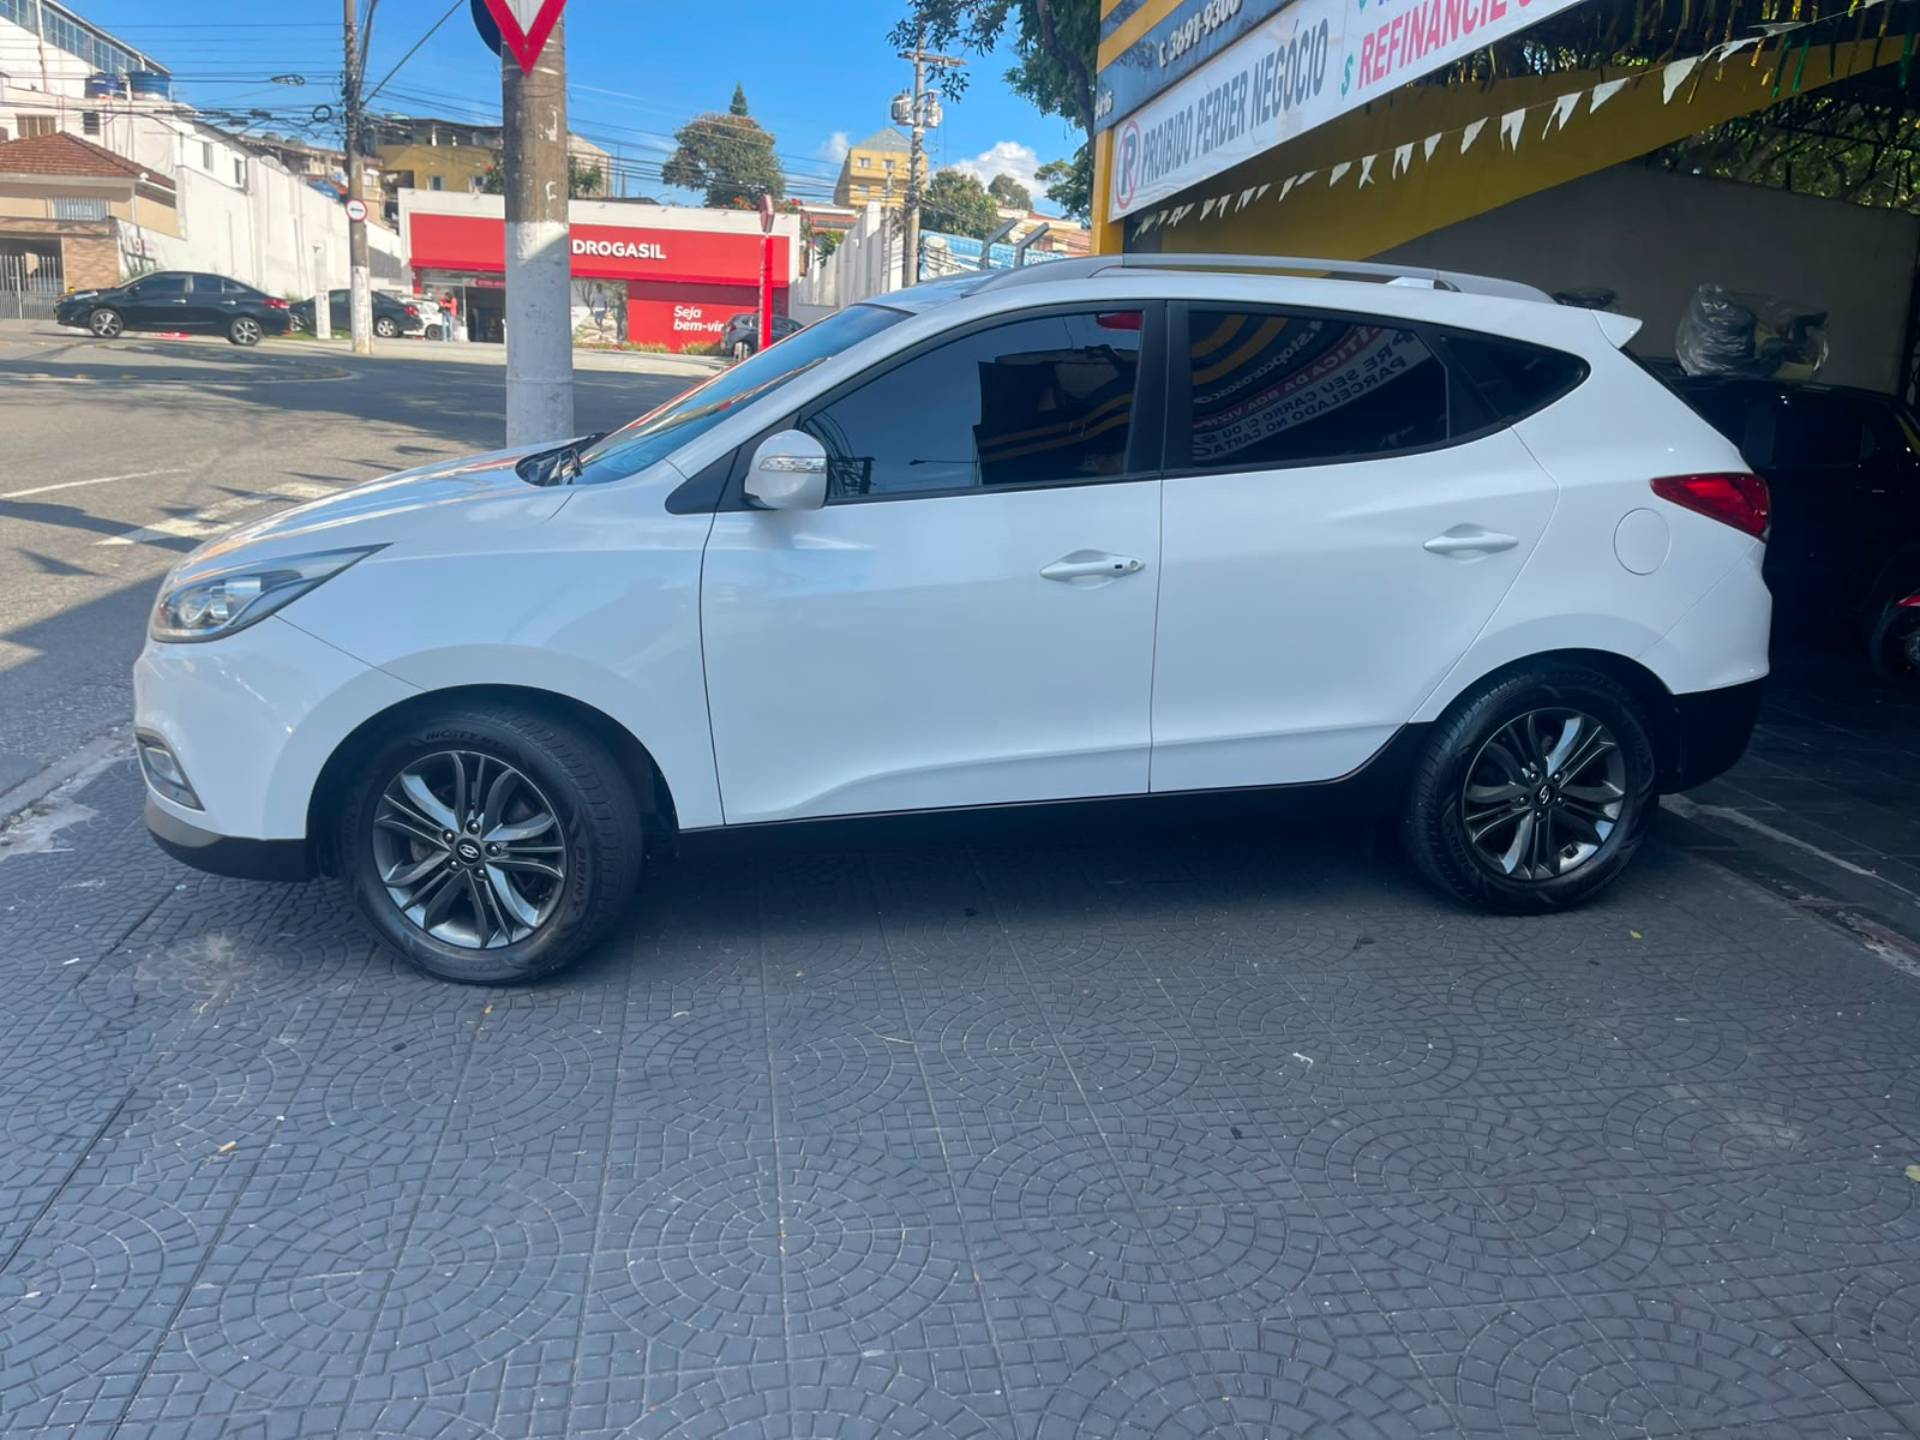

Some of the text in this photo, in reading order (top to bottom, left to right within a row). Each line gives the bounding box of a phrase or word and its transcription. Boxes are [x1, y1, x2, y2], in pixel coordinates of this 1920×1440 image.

[1141, 105, 1193, 186] PROIBIDO
[1195, 71, 1248, 159] PERDER
[1251, 18, 1328, 129] NEGÓCIO
[572, 239, 667, 260] DROGASIL
[673, 305, 702, 321] Seja
[673, 320, 724, 333] bem-vi
